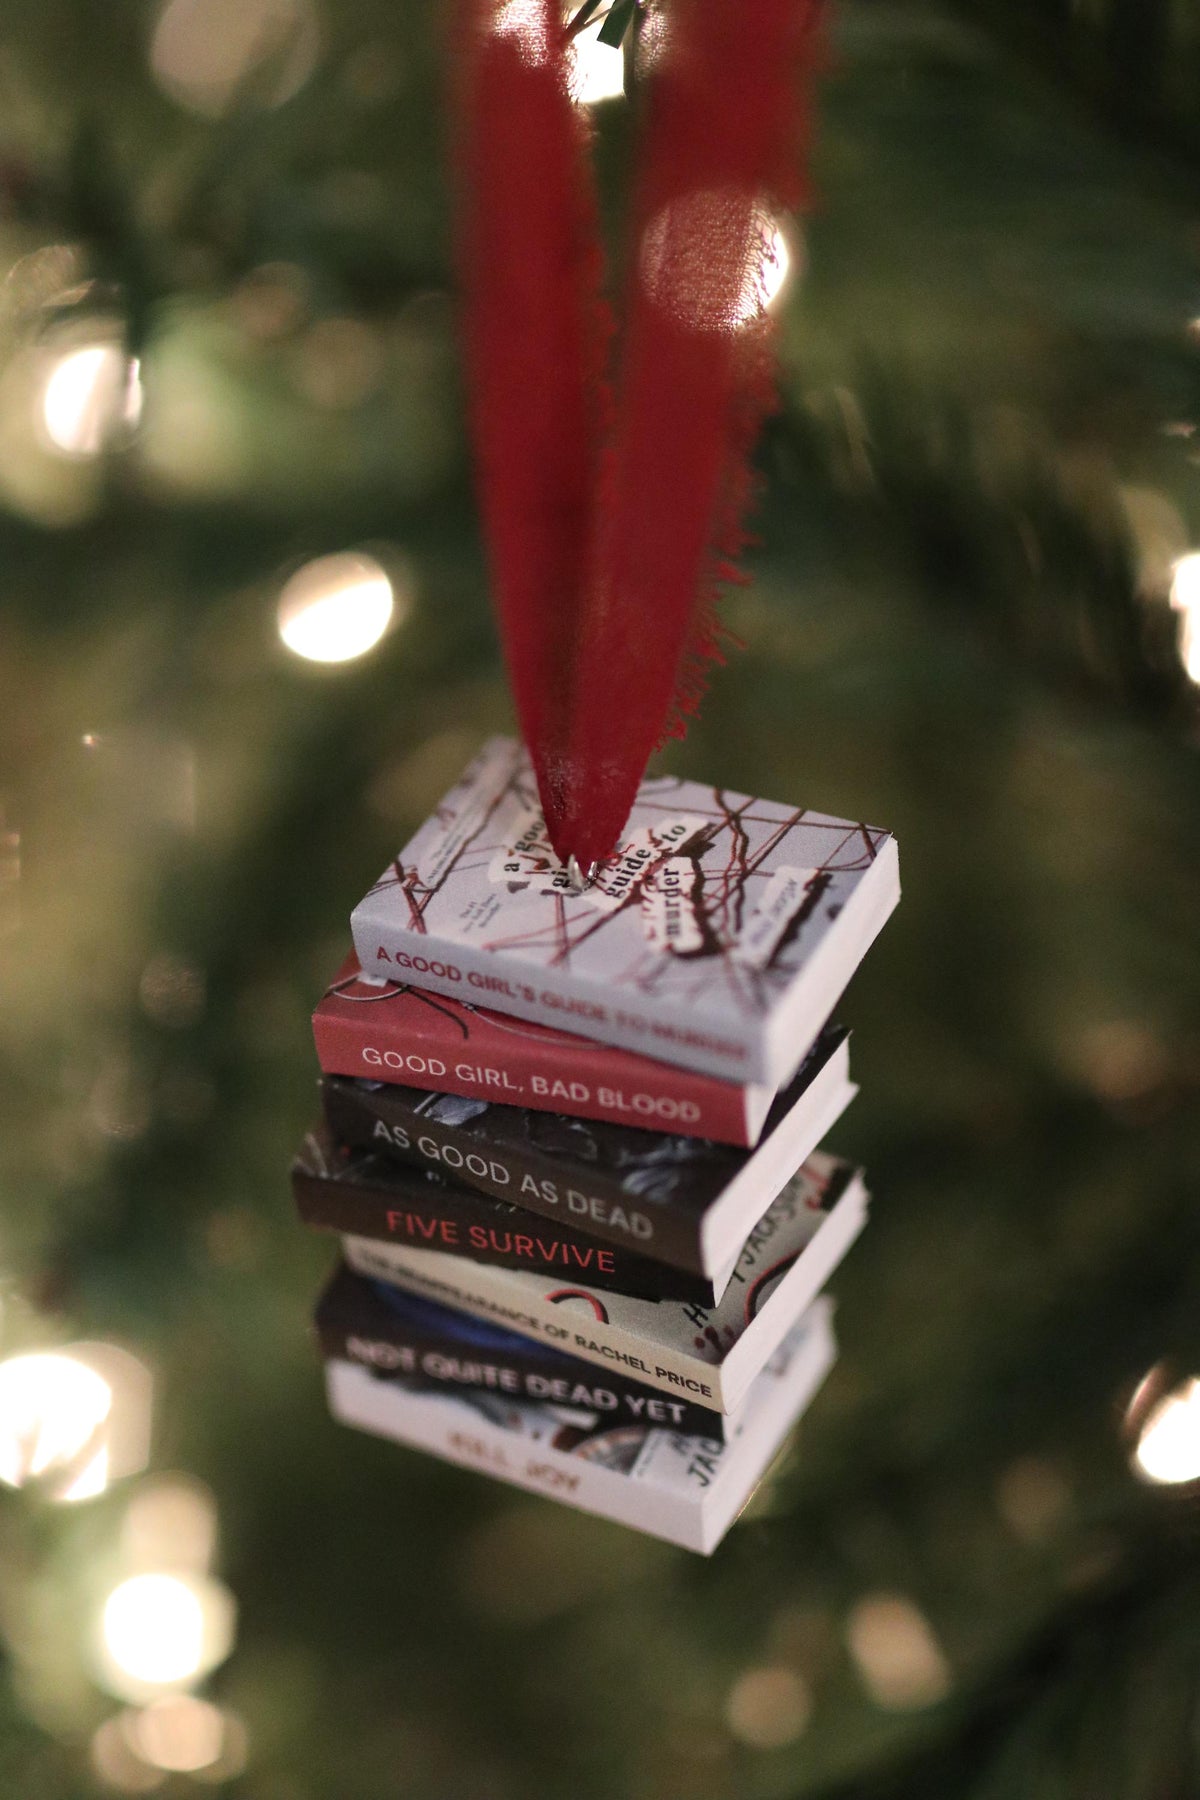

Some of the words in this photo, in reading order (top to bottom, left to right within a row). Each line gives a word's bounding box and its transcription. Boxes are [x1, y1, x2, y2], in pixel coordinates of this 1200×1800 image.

[503, 862, 520, 873] a
[514, 821, 545, 852] goo
[605, 848, 651, 899] guide
[661, 824, 687, 853] to
[661, 868, 680, 936] murder
[376, 946, 392, 964] A
[396, 952, 463, 982] GOOD
[467, 971, 536, 1002] GIRL'S
[362, 1048, 447, 1076] GOOD
[455, 1064, 524, 1092] GIRL,
[531, 1076, 591, 1102] BAD
[597, 1086, 702, 1123] BLOOD
[373, 1120, 410, 1148] AS
[418, 1136, 510, 1184] GOOD
[520, 1174, 559, 1204] AS
[567, 1189, 653, 1240] DEAD
[386, 1210, 460, 1244] FIVE
[469, 1225, 616, 1273] SURVIVE
[422, 1352, 522, 1393] QUITE
[525, 1374, 619, 1411] DEAD
[624, 1394, 687, 1424] YET
[544, 1322, 570, 1340] OF
[574, 1333, 652, 1374] RACHEL
[655, 1365, 713, 1398] PRICE
